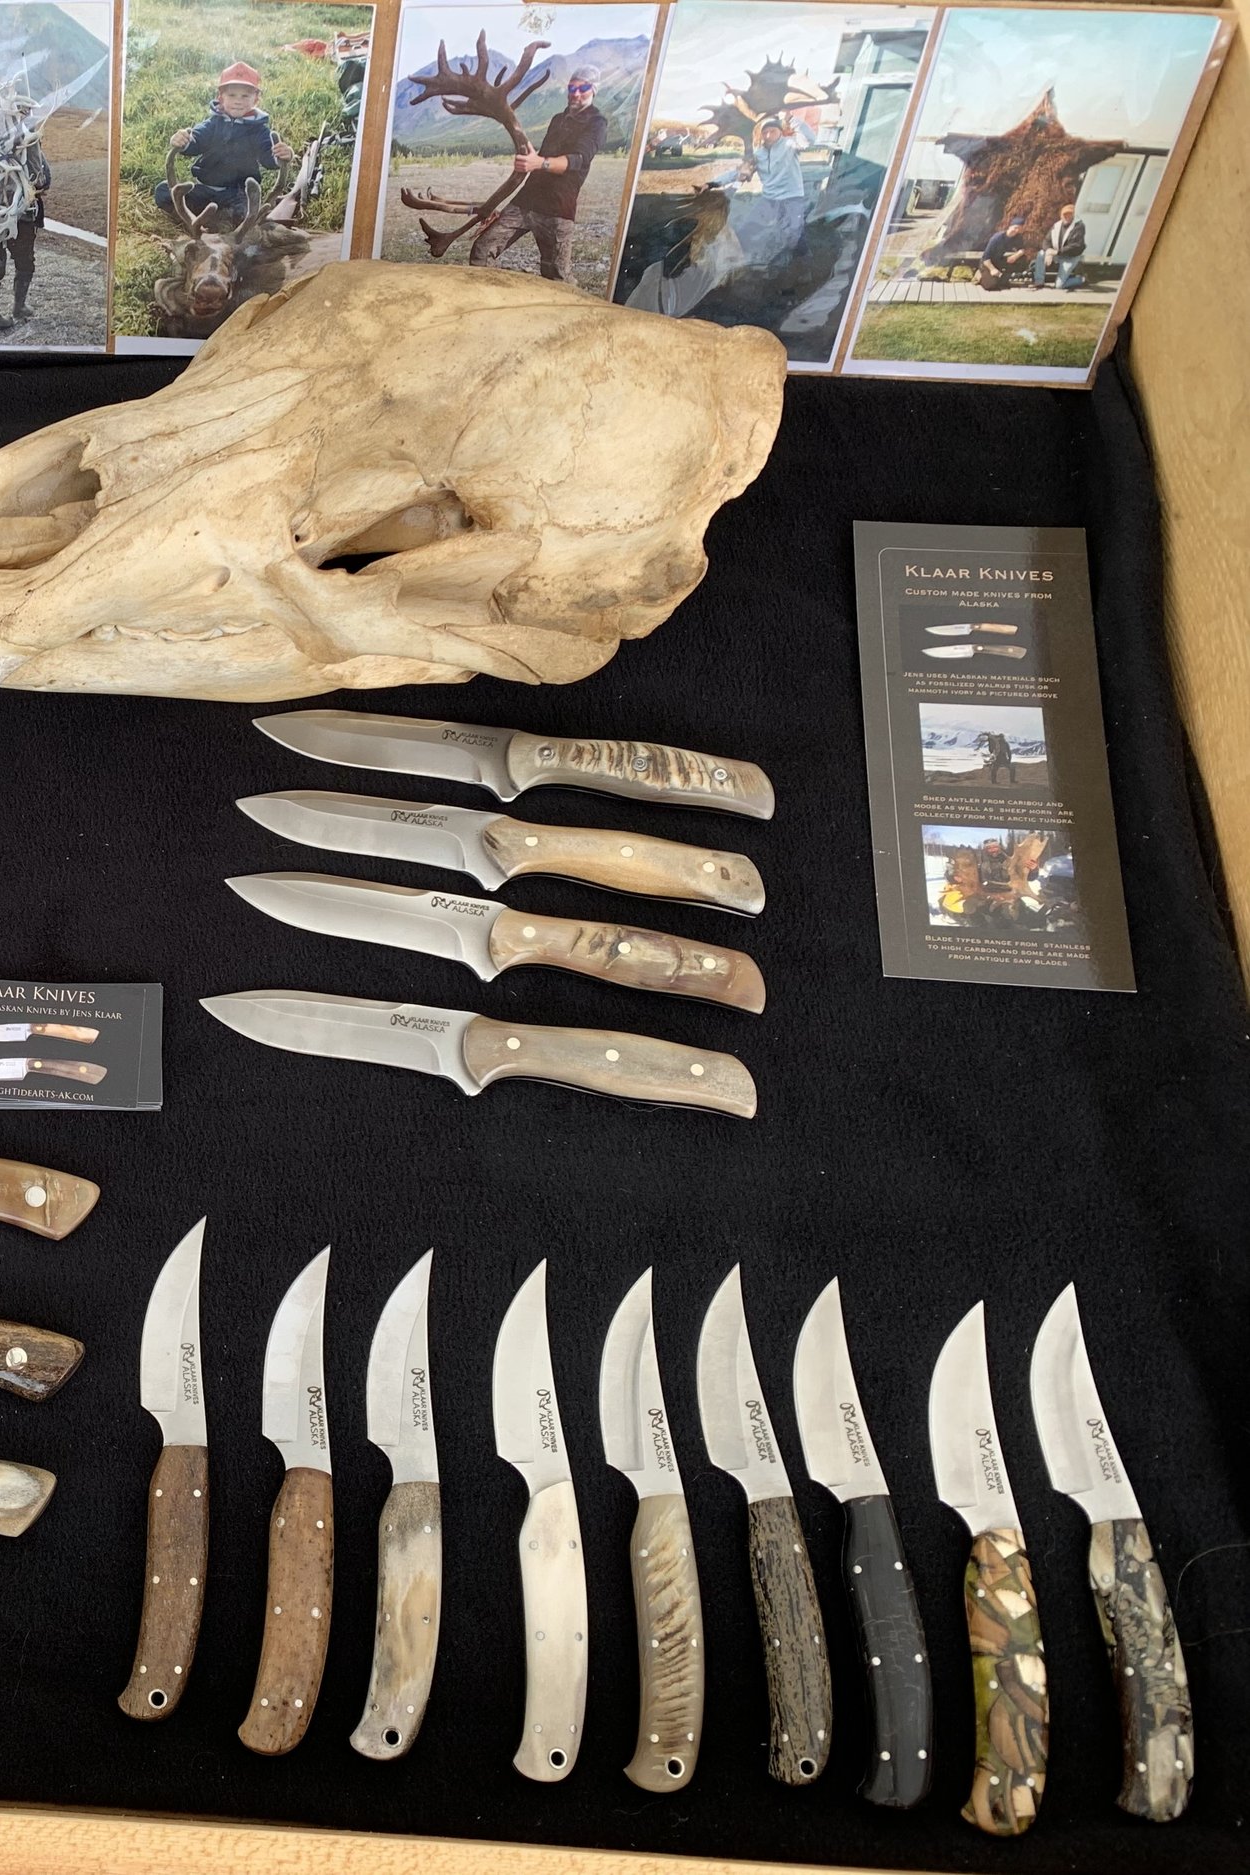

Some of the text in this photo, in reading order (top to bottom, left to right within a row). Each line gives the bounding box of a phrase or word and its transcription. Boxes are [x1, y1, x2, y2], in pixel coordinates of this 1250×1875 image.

[905, 565, 1054, 581] KLAAR KNIVES
[906, 588, 947, 596] CUSTOM
[411, 818, 444, 827] ALASKA
[452, 906, 484, 917] ALASKA
[33, 986, 96, 1004] KNIVES
[26, 1005, 58, 1015] KNIVES
[60, 1007, 71, 1016] BY
[73, 1009, 93, 1018] JENS
[95, 1010, 122, 1020] KLAAR
[182, 1366, 191, 1401] ALASKA
[412, 1391, 421, 1427] ALASKA
[539, 1412, 550, 1449] ALASKA
[652, 1432, 666, 1470] ALASKA
